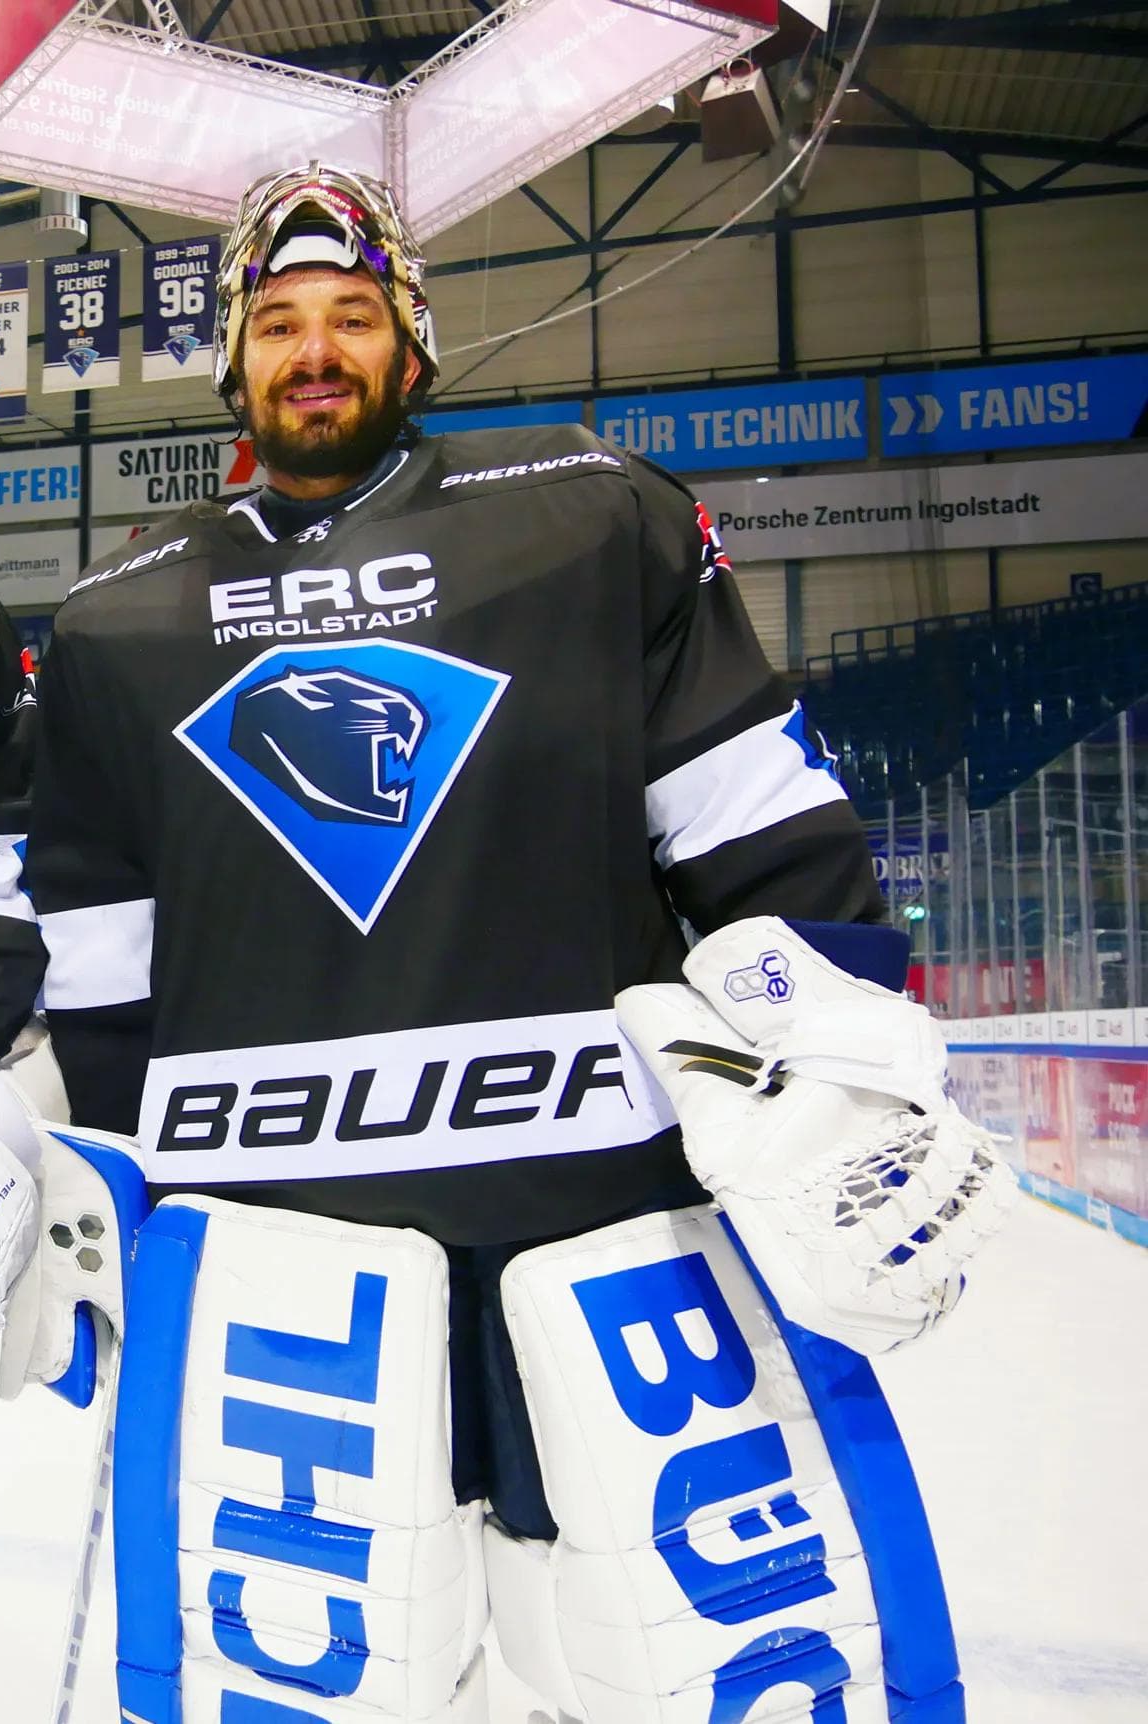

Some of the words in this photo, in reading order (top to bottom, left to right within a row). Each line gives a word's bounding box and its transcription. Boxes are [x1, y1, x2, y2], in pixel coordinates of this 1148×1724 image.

[56, 275, 107, 293] FICENEC
[153, 260, 211, 281] GOODALL
[58, 291, 105, 331] 38
[159, 277, 205, 318] 96
[67, 336, 95, 349] ERC
[168, 323, 196, 336] ERC
[959, 381, 1089, 430] FANS!
[603, 406, 677, 454] FÜR
[688, 399, 863, 450] TECHNIK
[118, 442, 220, 478] SATURN
[147, 471, 220, 504] CARD
[718, 508, 809, 532] Porsche
[815, 503, 912, 527] Zentrum
[918, 492, 1041, 524] Ingolstadt
[208, 552, 438, 623] ERC
[212, 599, 438, 646] INGOLSTADT
[207, 1271, 388, 1724] CHL
